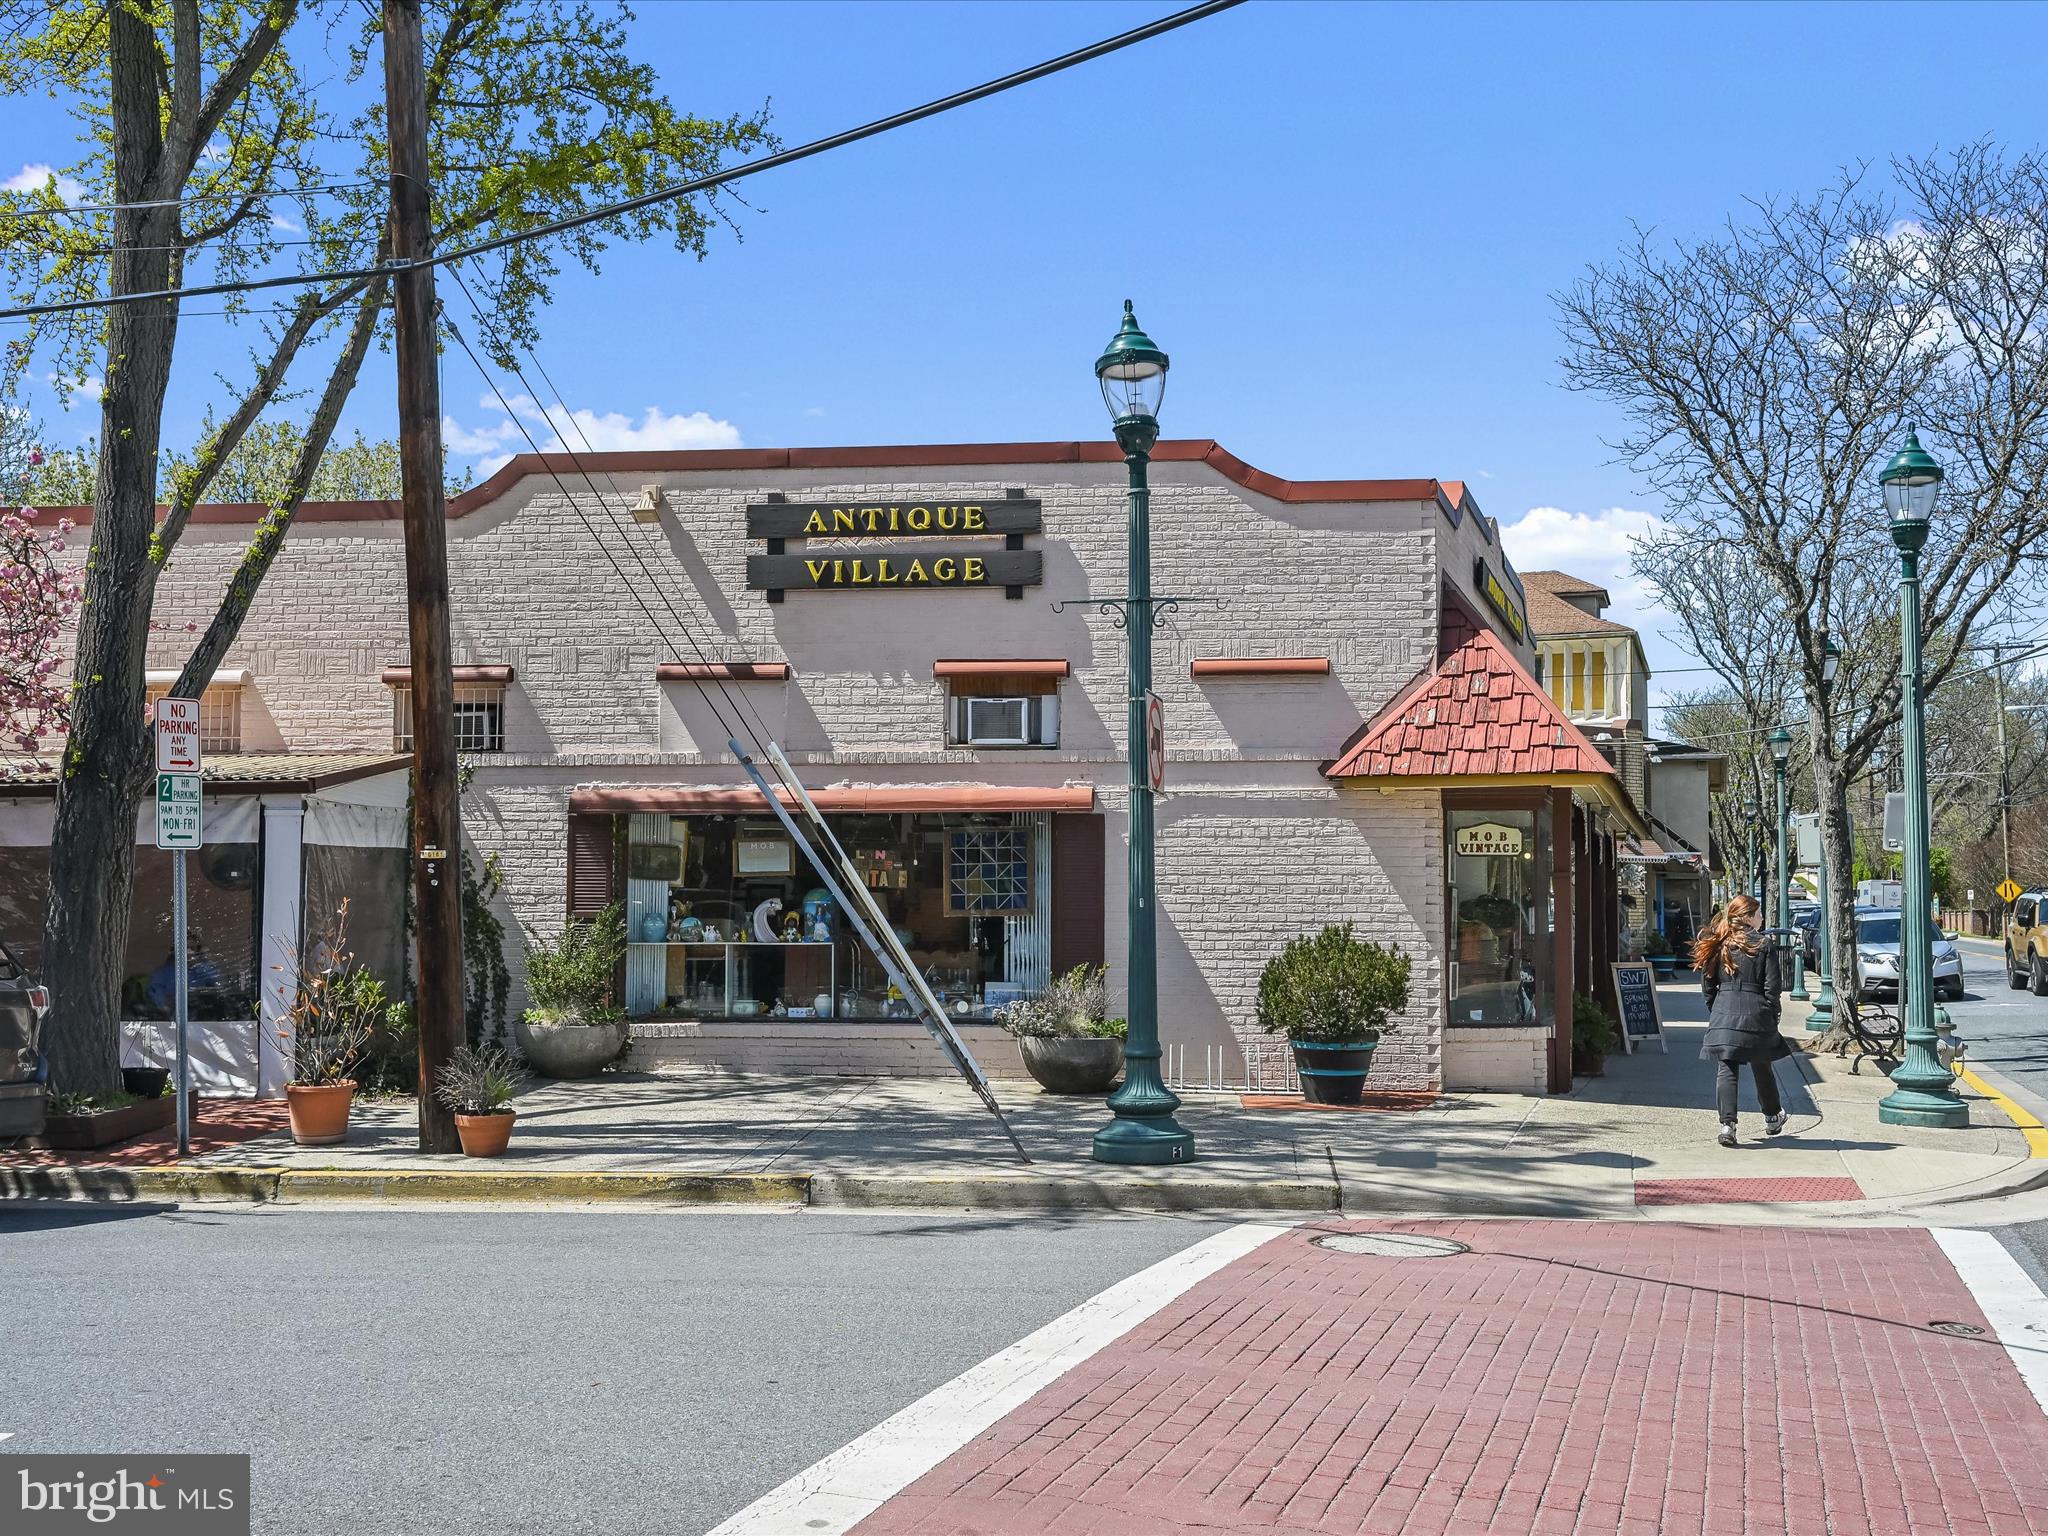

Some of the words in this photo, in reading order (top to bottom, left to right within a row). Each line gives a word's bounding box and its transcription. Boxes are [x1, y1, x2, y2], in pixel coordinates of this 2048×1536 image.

[803, 506, 985, 533] ANTIQUE
[804, 558, 985, 584] VILLAGE
[170, 704, 186, 718] NO
[159, 719, 198, 735] PARKING
[171, 735, 187, 745] ANY
[171, 746, 188, 757] TIME
[162, 778, 170, 797] 2
[181, 778, 190, 788] HR
[173, 790, 198, 801] PARKING
[160, 805, 173, 815] 9AM
[175, 805, 183, 815] TO
[185, 806, 198, 816] 5PM
[162, 818, 196, 830] MON-FRI
[1460, 843, 1519, 854] VINTAGE
[1620, 971, 1646, 985] SW7
[1172, 1145, 1183, 1159] F1
